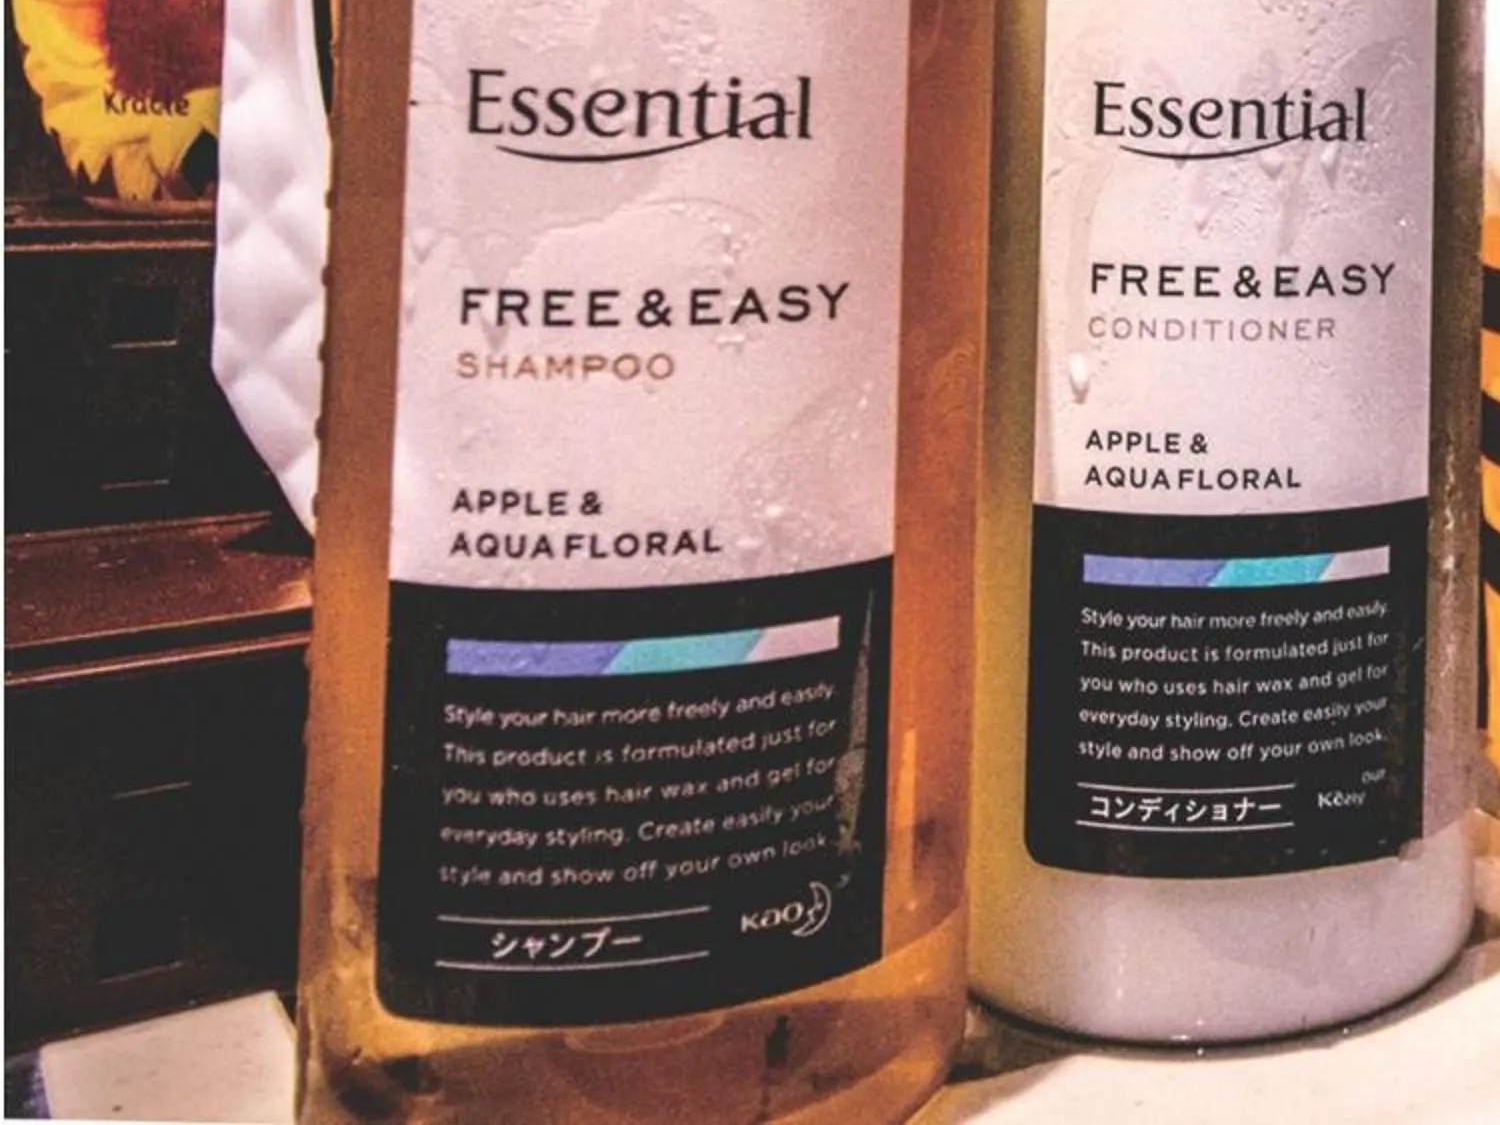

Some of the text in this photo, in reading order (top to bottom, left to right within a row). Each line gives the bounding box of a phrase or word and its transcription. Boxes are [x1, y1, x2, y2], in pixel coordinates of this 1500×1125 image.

[468, 68, 812, 145] Essential
[1093, 81, 1368, 147] Essential
[1087, 315, 1336, 342] CONDITIONER
[457, 352, 676, 381] SHAMPOO
[1085, 429, 1209, 454] APPLE &
[1084, 465, 1302, 491] AQUA FLORAL
[451, 489, 603, 516] APPLE &
[450, 528, 723, 560] AQUA FLORAL
[1081, 606, 1123, 628] Style
[1127, 612, 1166, 631] your
[1170, 612, 1205, 630] hair
[1209, 615, 1257, 629] more
[1260, 608, 1309, 628] freely
[1313, 605, 1344, 624] and
[1080, 631, 1389, 664] This product is formulated just for
[1080, 663, 1389, 696] you who uses hair wax and gel for
[443, 703, 494, 730] Style
[498, 708, 548, 732] your
[553, 708, 596, 728] hair
[601, 706, 662, 726] more
[667, 698, 730, 723] freely
[735, 689, 775, 714] and
[1078, 707, 1160, 730] everyday
[1239, 707, 1300, 727] Create
[1302, 701, 1351, 723] easily
[1353, 695, 1389, 717] your
[443, 717, 837, 770] This product is formulated just for
[1077, 739, 1123, 761] style
[1127, 743, 1164, 761] and
[1169, 743, 1221, 761] show
[1227, 743, 1255, 761] off
[1259, 741, 1301, 762] your
[1308, 736, 1346, 755] own
[442, 754, 837, 808] you who uses hair wax and gel for
[439, 824, 538, 850] everyday
[637, 815, 717, 843] Create
[788, 794, 836, 821] your
[1090, 794, 1283, 822] コンディショナー
[439, 865, 493, 889] style
[497, 864, 543, 886] and
[550, 862, 617, 886] show
[623, 859, 659, 883] off
[665, 855, 720, 882] your
[726, 845, 777, 871] own
[490, 925, 643, 959] シャンプー
